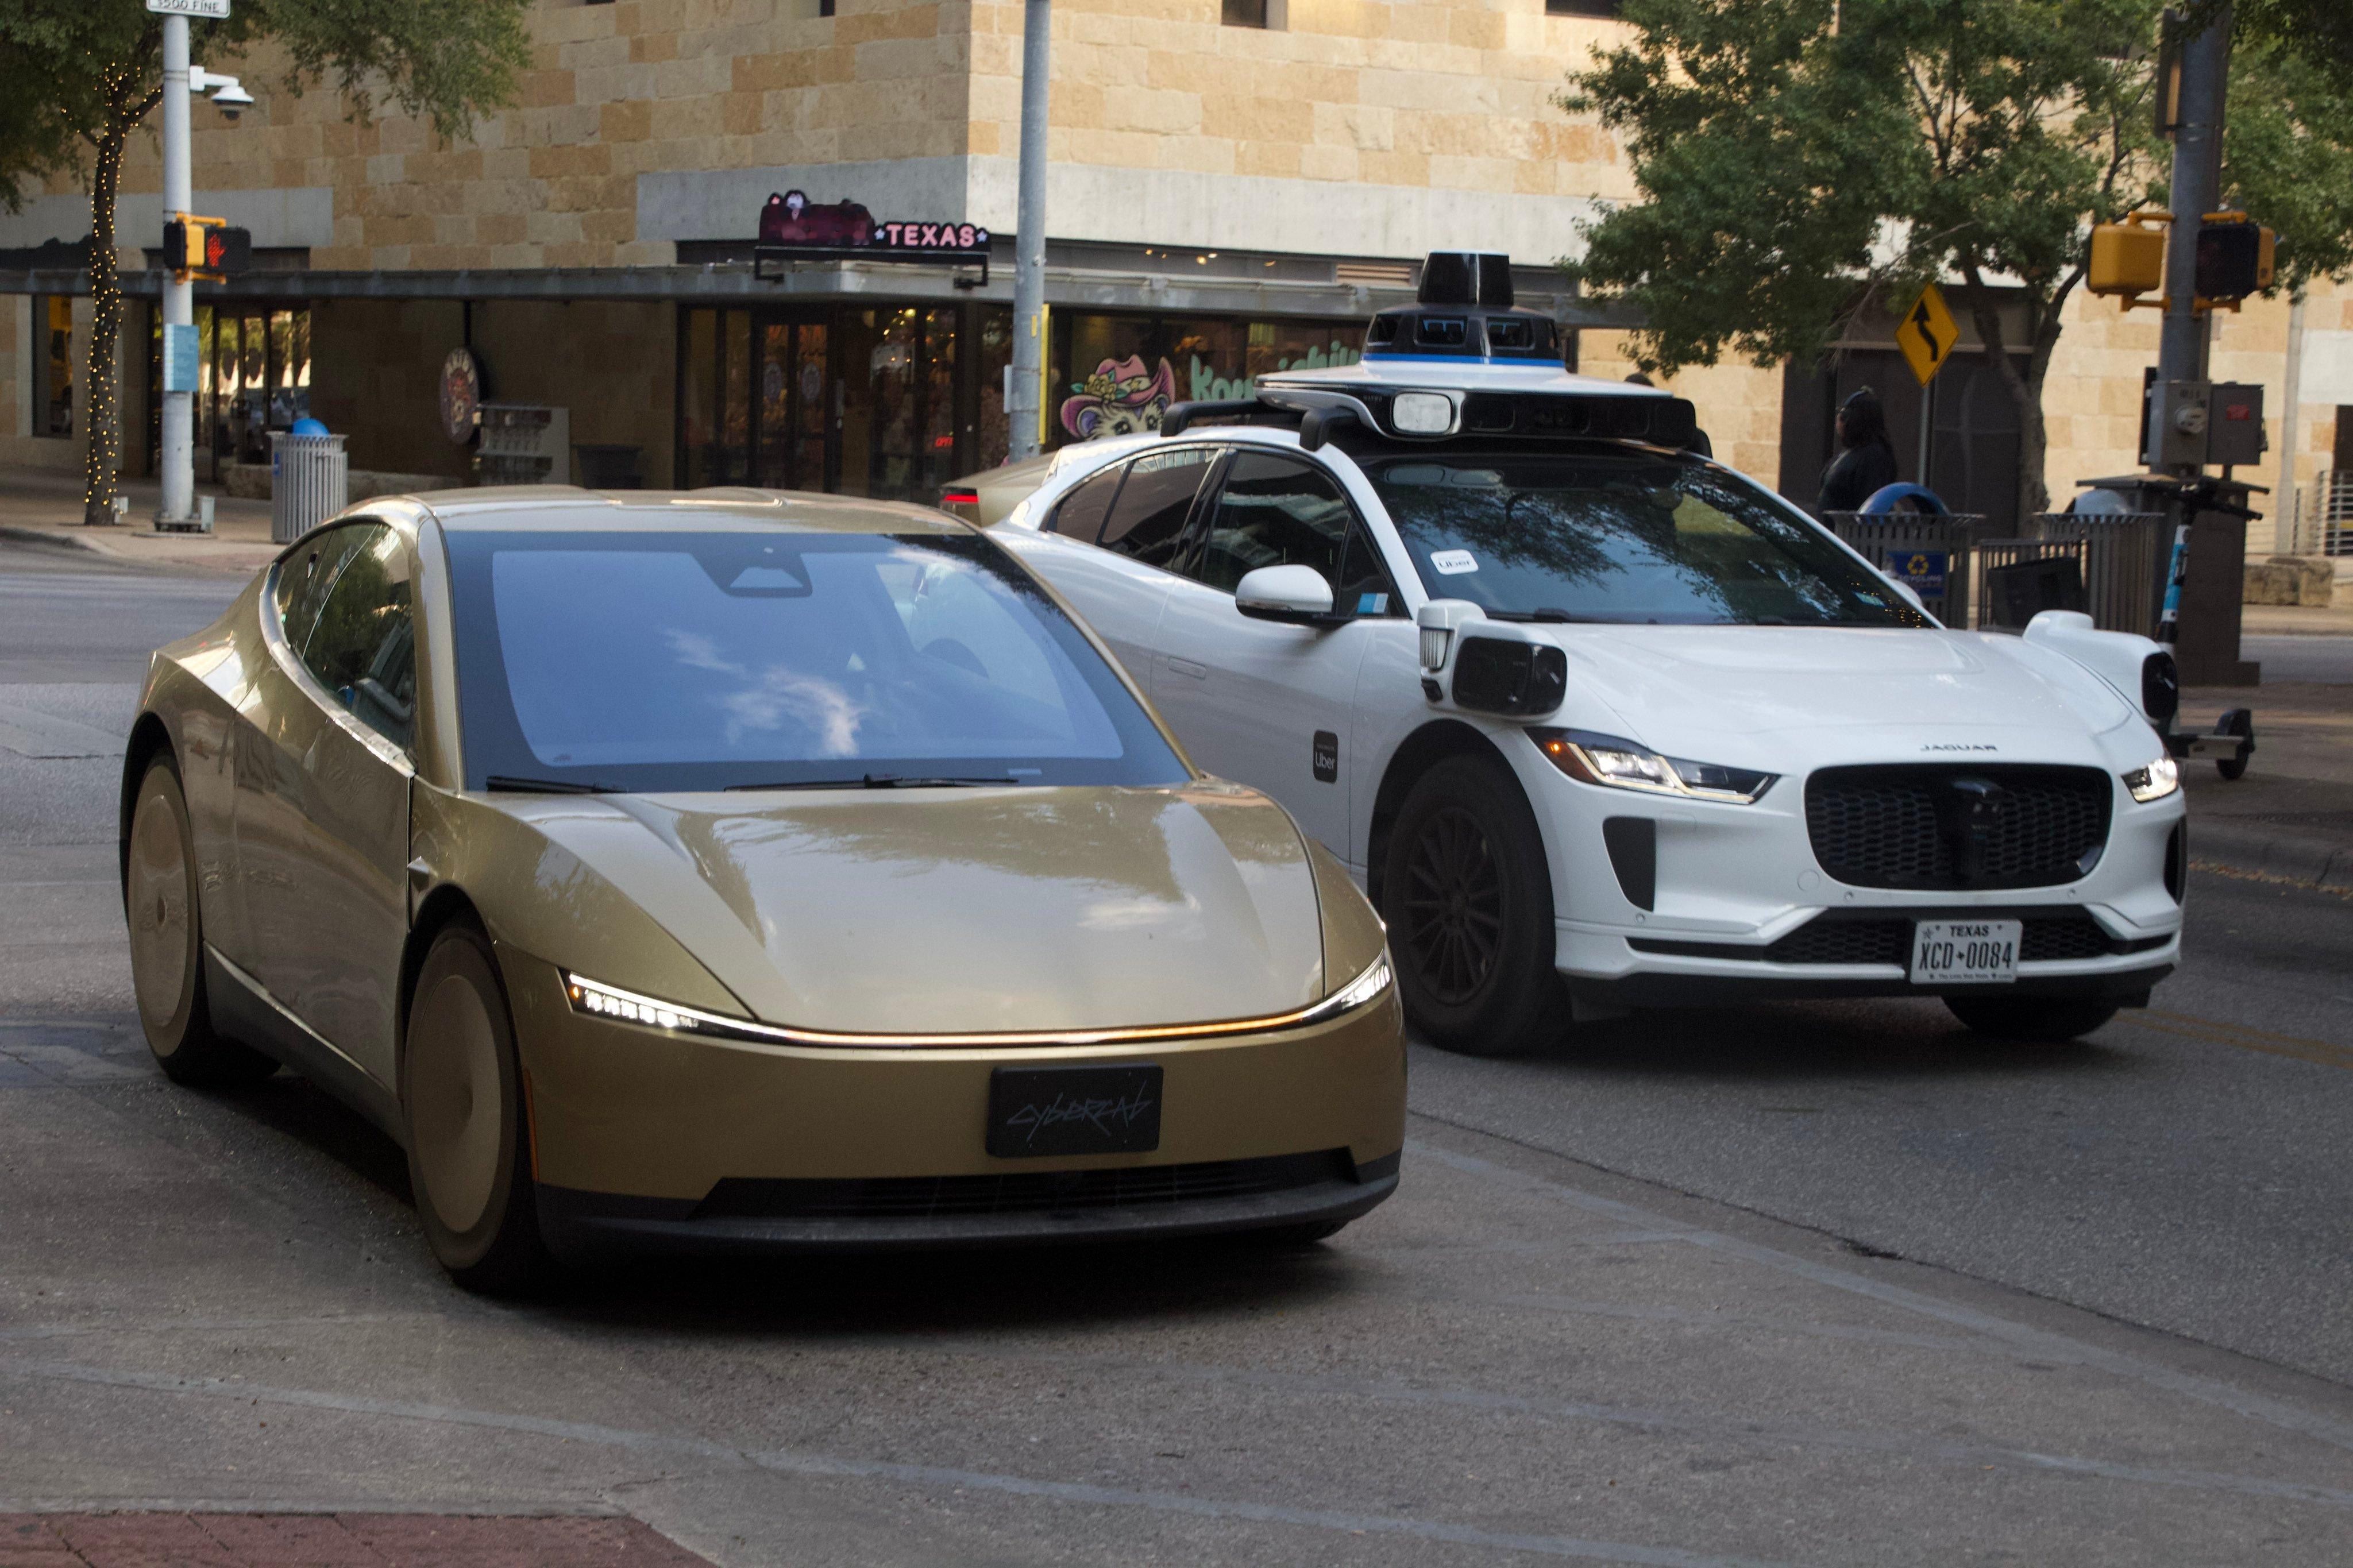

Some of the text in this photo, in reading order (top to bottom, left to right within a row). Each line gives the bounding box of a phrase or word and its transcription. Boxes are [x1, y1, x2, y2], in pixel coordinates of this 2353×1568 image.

[886, 223, 975, 248] TEXAS
[1315, 751, 1336, 770] Uber
[1950, 924, 1989, 937] TEXAS
